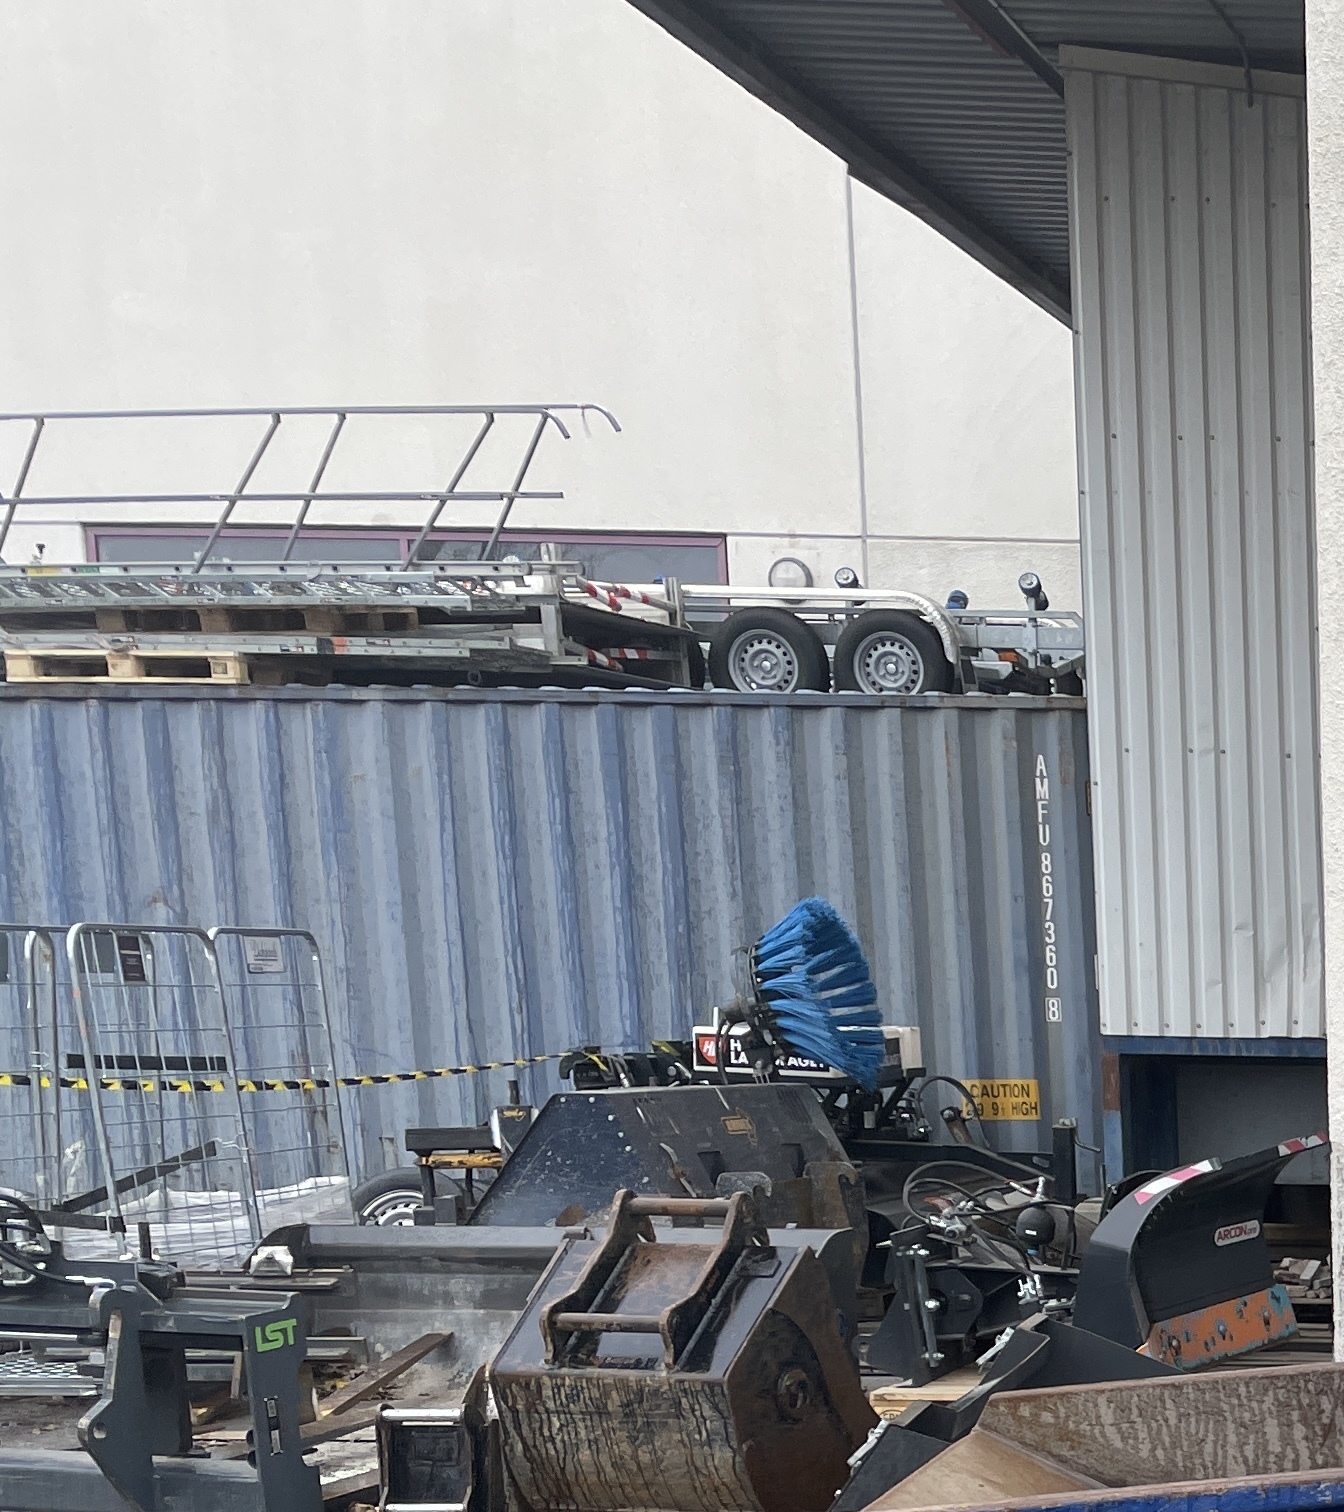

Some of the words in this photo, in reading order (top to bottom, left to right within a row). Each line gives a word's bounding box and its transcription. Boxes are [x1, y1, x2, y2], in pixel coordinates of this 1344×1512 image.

[1034, 754, 1050, 846] AMFU
[1041, 852, 1058, 989] 867360
[1048, 999, 1059, 1021] 8
[969, 1083, 1030, 1099] CAUTION
[1011, 1101, 1038, 1116] HIGH
[254, 1318, 298, 1353] LST
